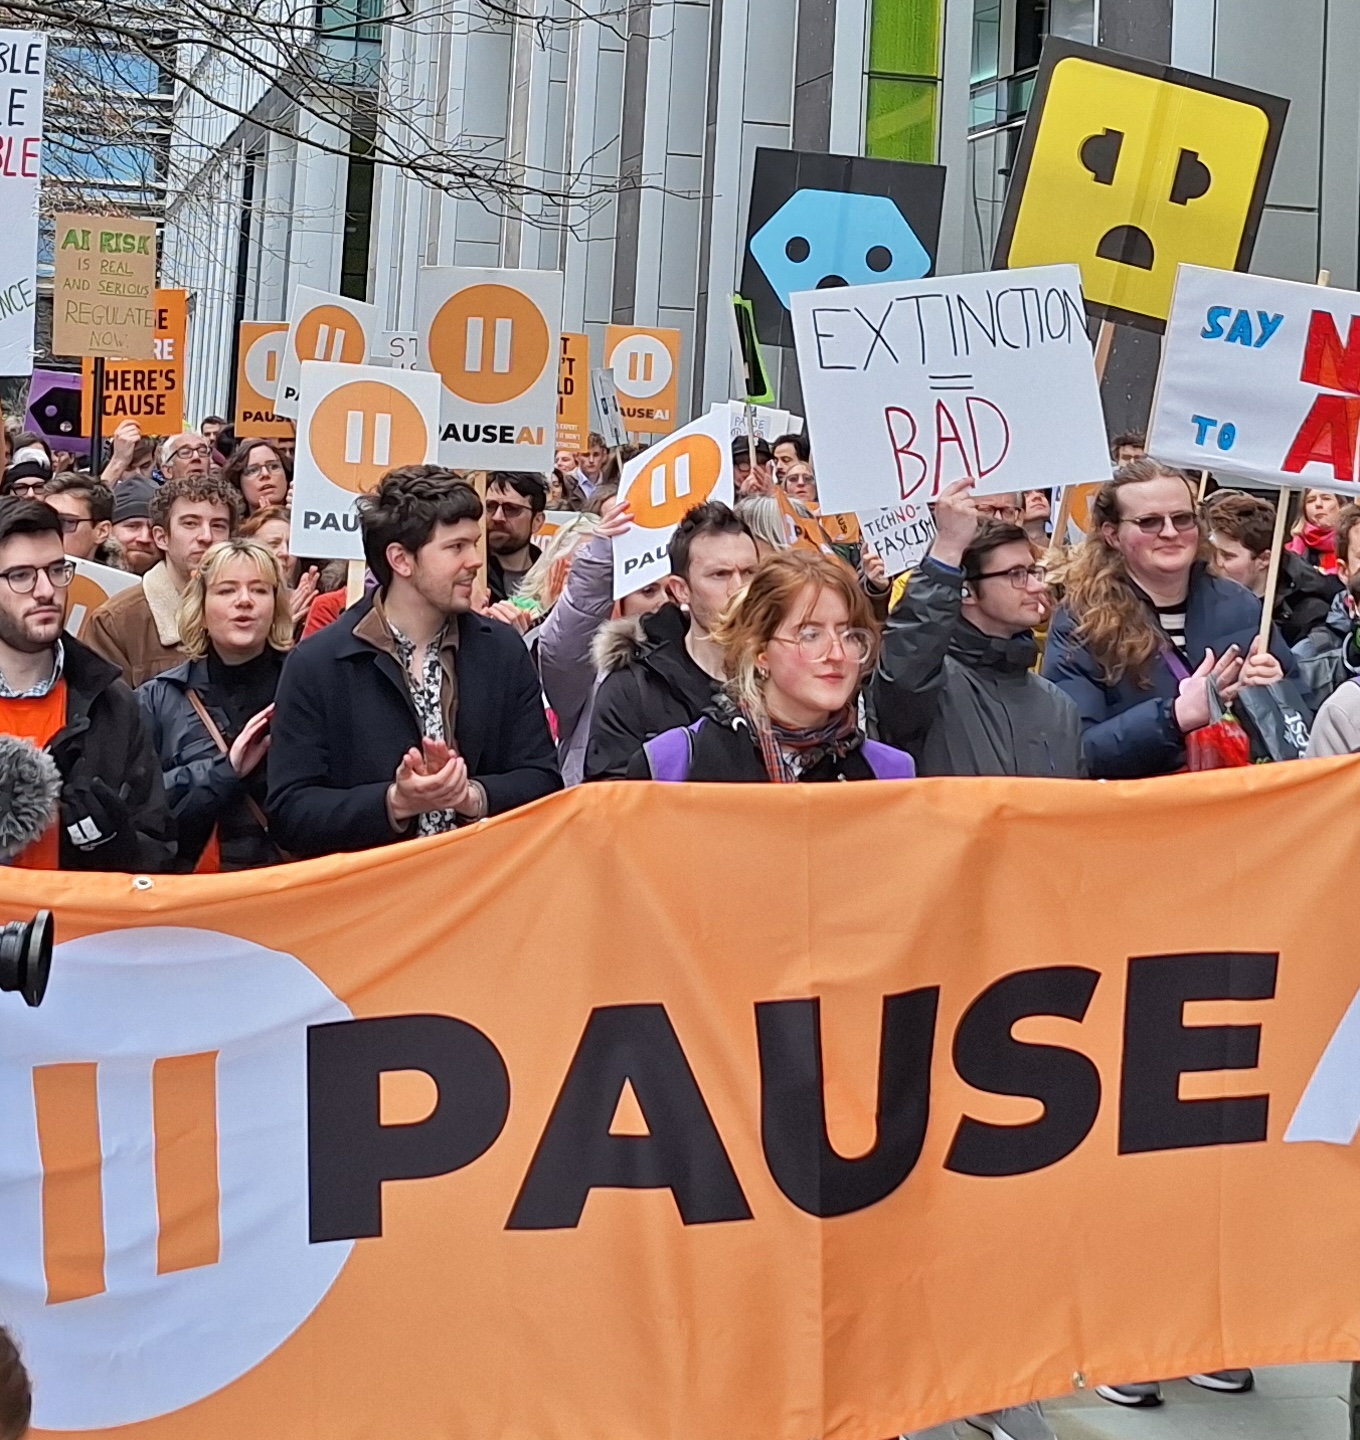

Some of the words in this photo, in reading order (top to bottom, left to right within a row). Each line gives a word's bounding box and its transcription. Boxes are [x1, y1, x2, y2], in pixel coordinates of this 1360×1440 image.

[61, 229, 91, 251] AI
[99, 231, 152, 255] RISK
[77, 257, 90, 271] IS
[100, 259, 134, 275] REAL
[62, 277, 90, 292] AND
[97, 280, 149, 296] SERIOUS
[65, 300, 156, 328] REGULATE
[1200, 305, 1285, 349] SAY
[812, 284, 1090, 371] EXTINCTION
[91, 369, 176, 391] HERE'S
[439, 423, 545, 446] AUSEAI
[734, 416, 765, 430] PASE
[1191, 414, 1237, 451] TO
[884, 396, 1010, 500] BAD
